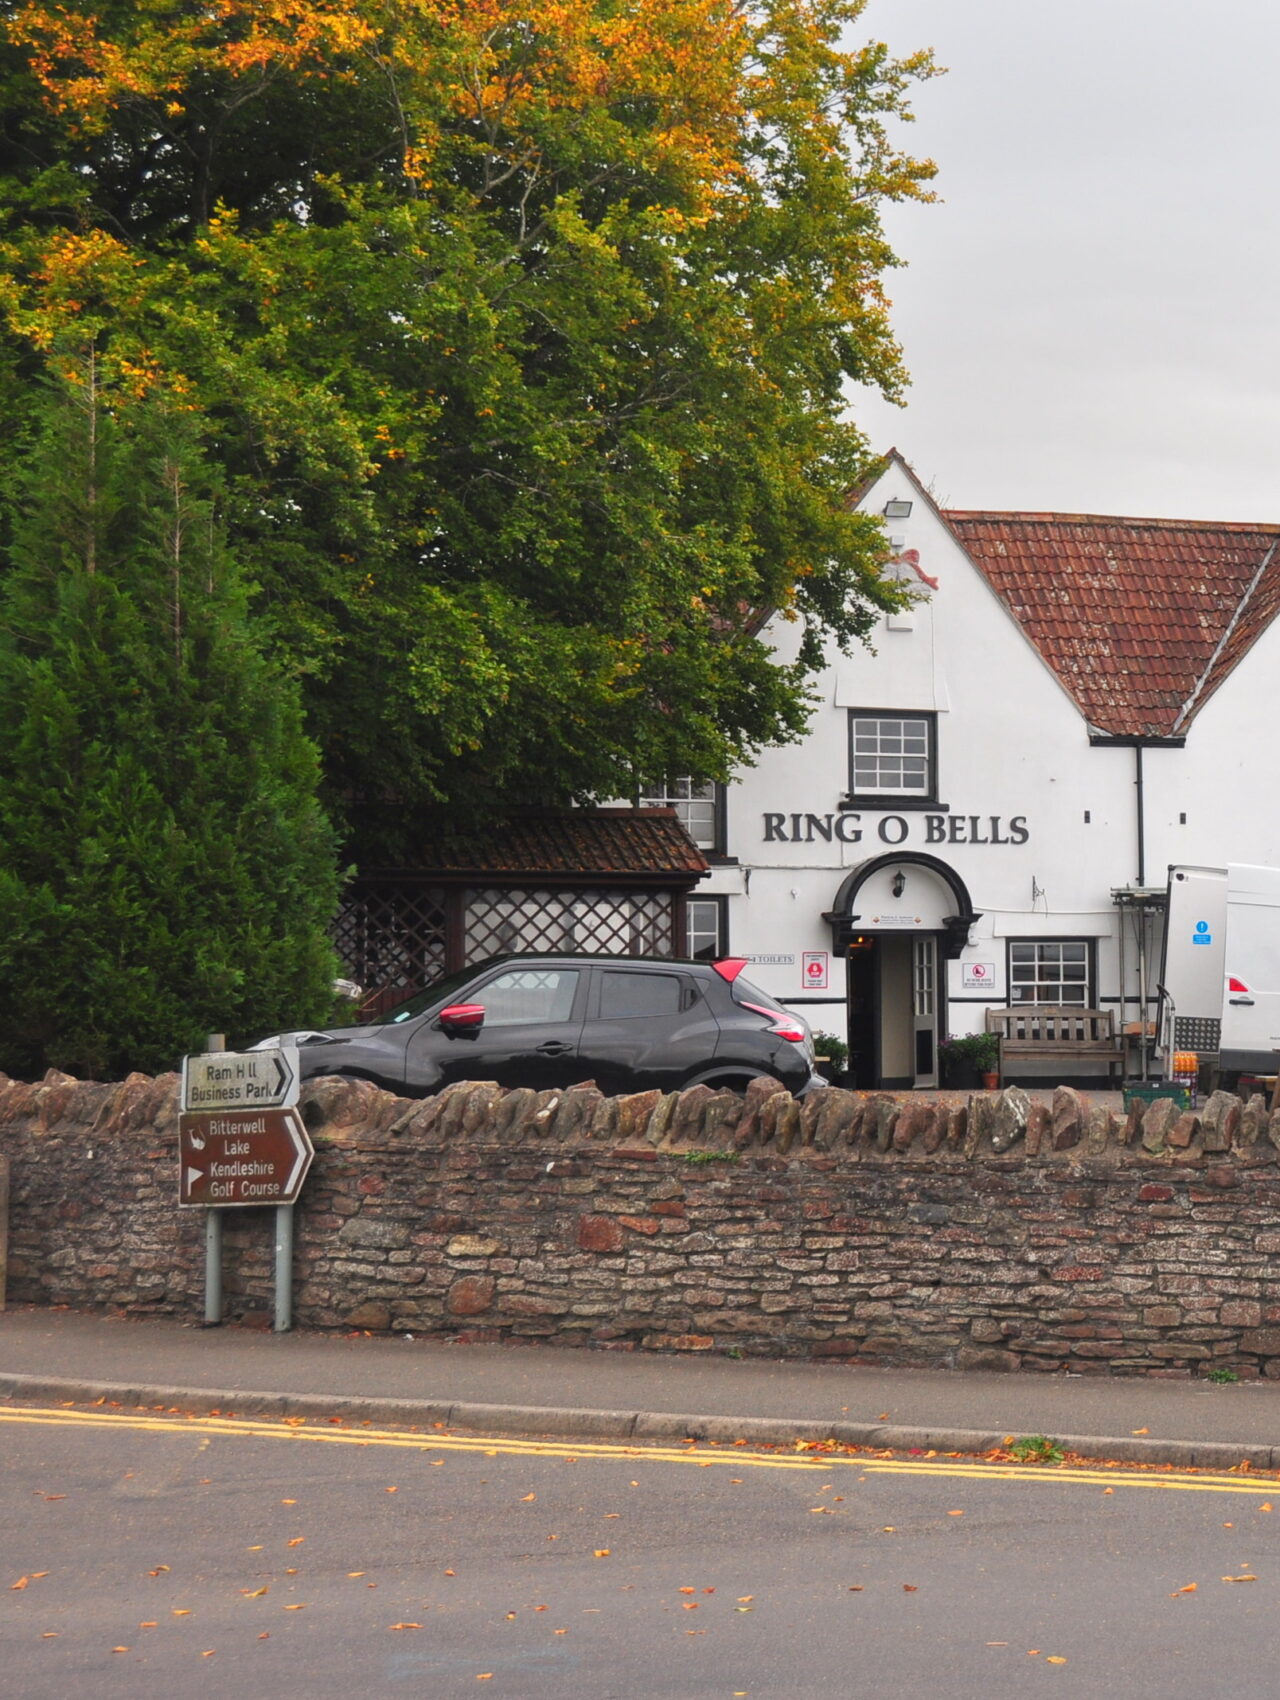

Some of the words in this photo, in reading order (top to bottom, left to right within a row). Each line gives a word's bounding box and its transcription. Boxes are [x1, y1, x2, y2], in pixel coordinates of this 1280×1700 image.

[763, 812, 863, 843] RING
[878, 815, 909, 844] O
[925, 815, 1030, 845] BELLS
[207, 1066, 232, 1080] Ram
[236, 1062, 257, 1079] Hll
[192, 1085, 241, 1101] Business
[246, 1082, 272, 1099] Park
[210, 1118, 266, 1136] Bitterwell
[225, 1140, 250, 1155] Lake
[210, 1160, 275, 1177] Kendleshire
[210, 1181, 235, 1197] Golf
[241, 1180, 280, 1196] Course
